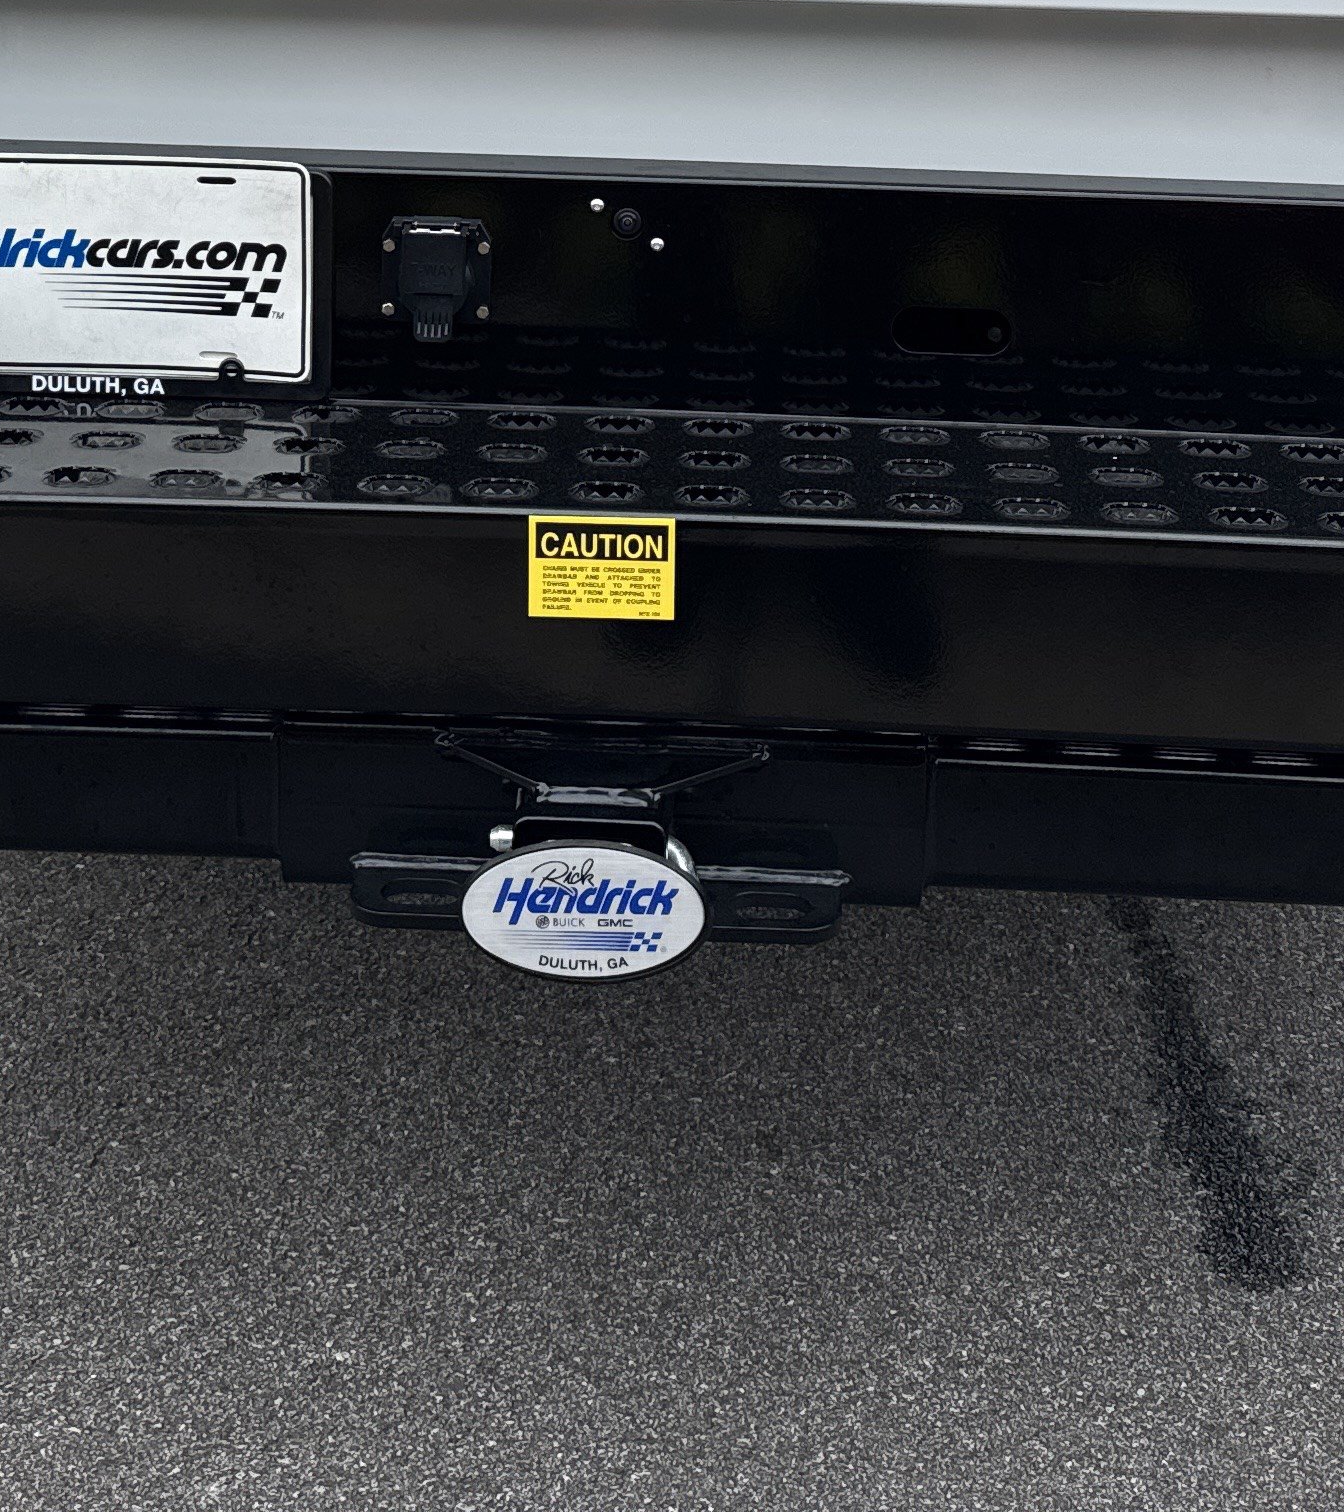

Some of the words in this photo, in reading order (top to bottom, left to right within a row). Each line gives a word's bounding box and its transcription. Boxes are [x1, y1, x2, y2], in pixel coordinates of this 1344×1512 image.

[30, 373, 127, 397] DULUTH,
[133, 375, 165, 396] GA
[540, 531, 663, 559] CAUTION
[530, 857, 597, 896] Rick
[492, 877, 679, 925] Hendrick
[552, 917, 586, 927] BUICK
[597, 918, 633, 927] GMC
[538, 954, 603, 972] DULUTH,
[606, 956, 629, 970] GA
